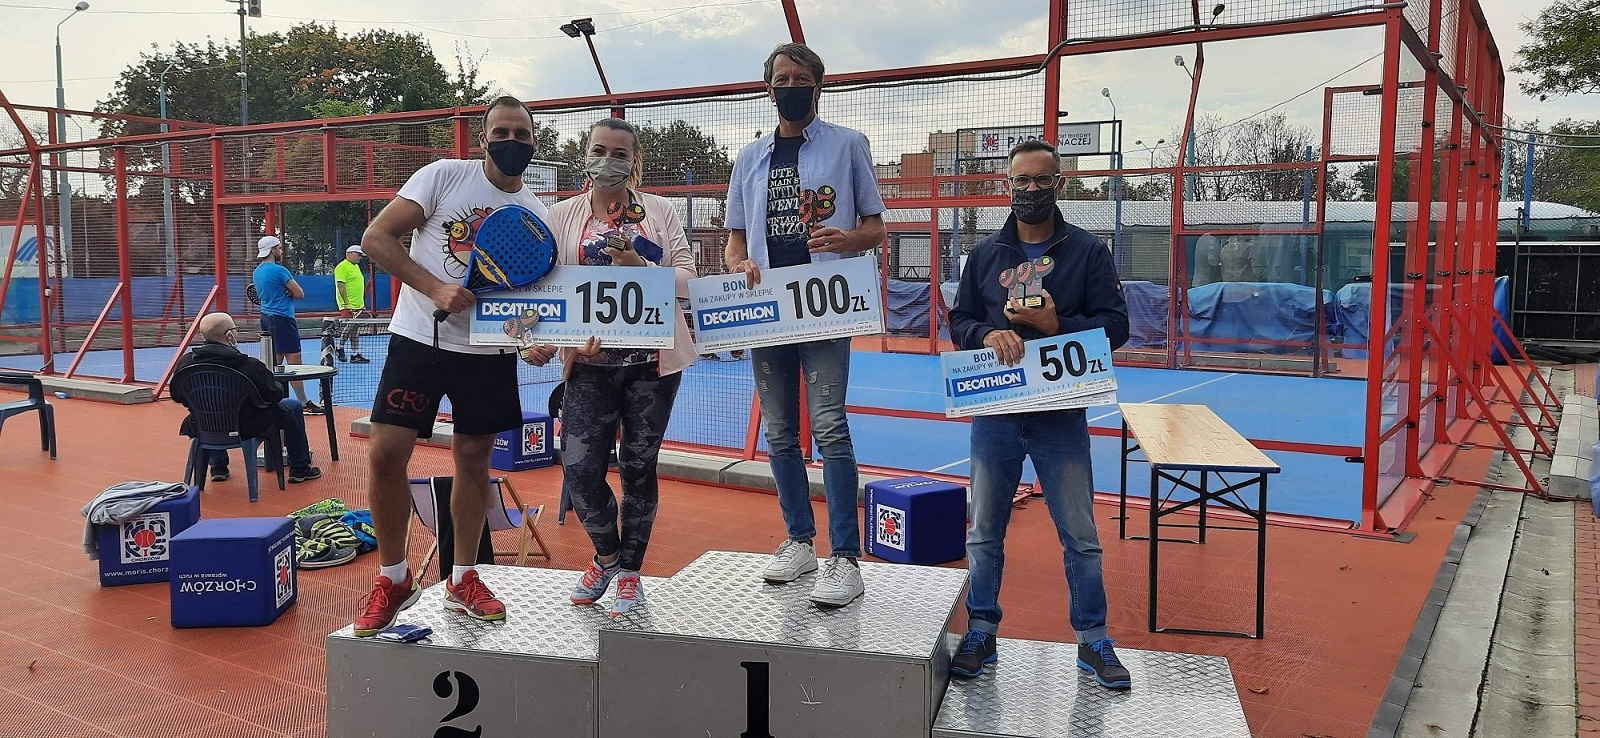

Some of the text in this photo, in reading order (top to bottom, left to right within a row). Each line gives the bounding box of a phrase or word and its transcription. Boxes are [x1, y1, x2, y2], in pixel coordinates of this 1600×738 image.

[770, 167, 794, 179] UTE
[770, 179, 792, 188] MAIN
[767, 221, 807, 237] RIZO
[533, 284, 564, 293] SKLEPIE
[722, 279, 747, 292] BON
[698, 287, 774, 305] NA ZAKUPY W SKLEPIE
[702, 305, 775, 326] DECATHLON
[973, 351, 995, 363] BON
[952, 367, 962, 375] NA
[963, 362, 987, 373] ZAKUPY
[987, 360, 994, 368] W
[956, 371, 1022, 393] DECATHLON
[179, 578, 257, 595] CHORZÓW
[432, 661, 776, 738] 2 1
